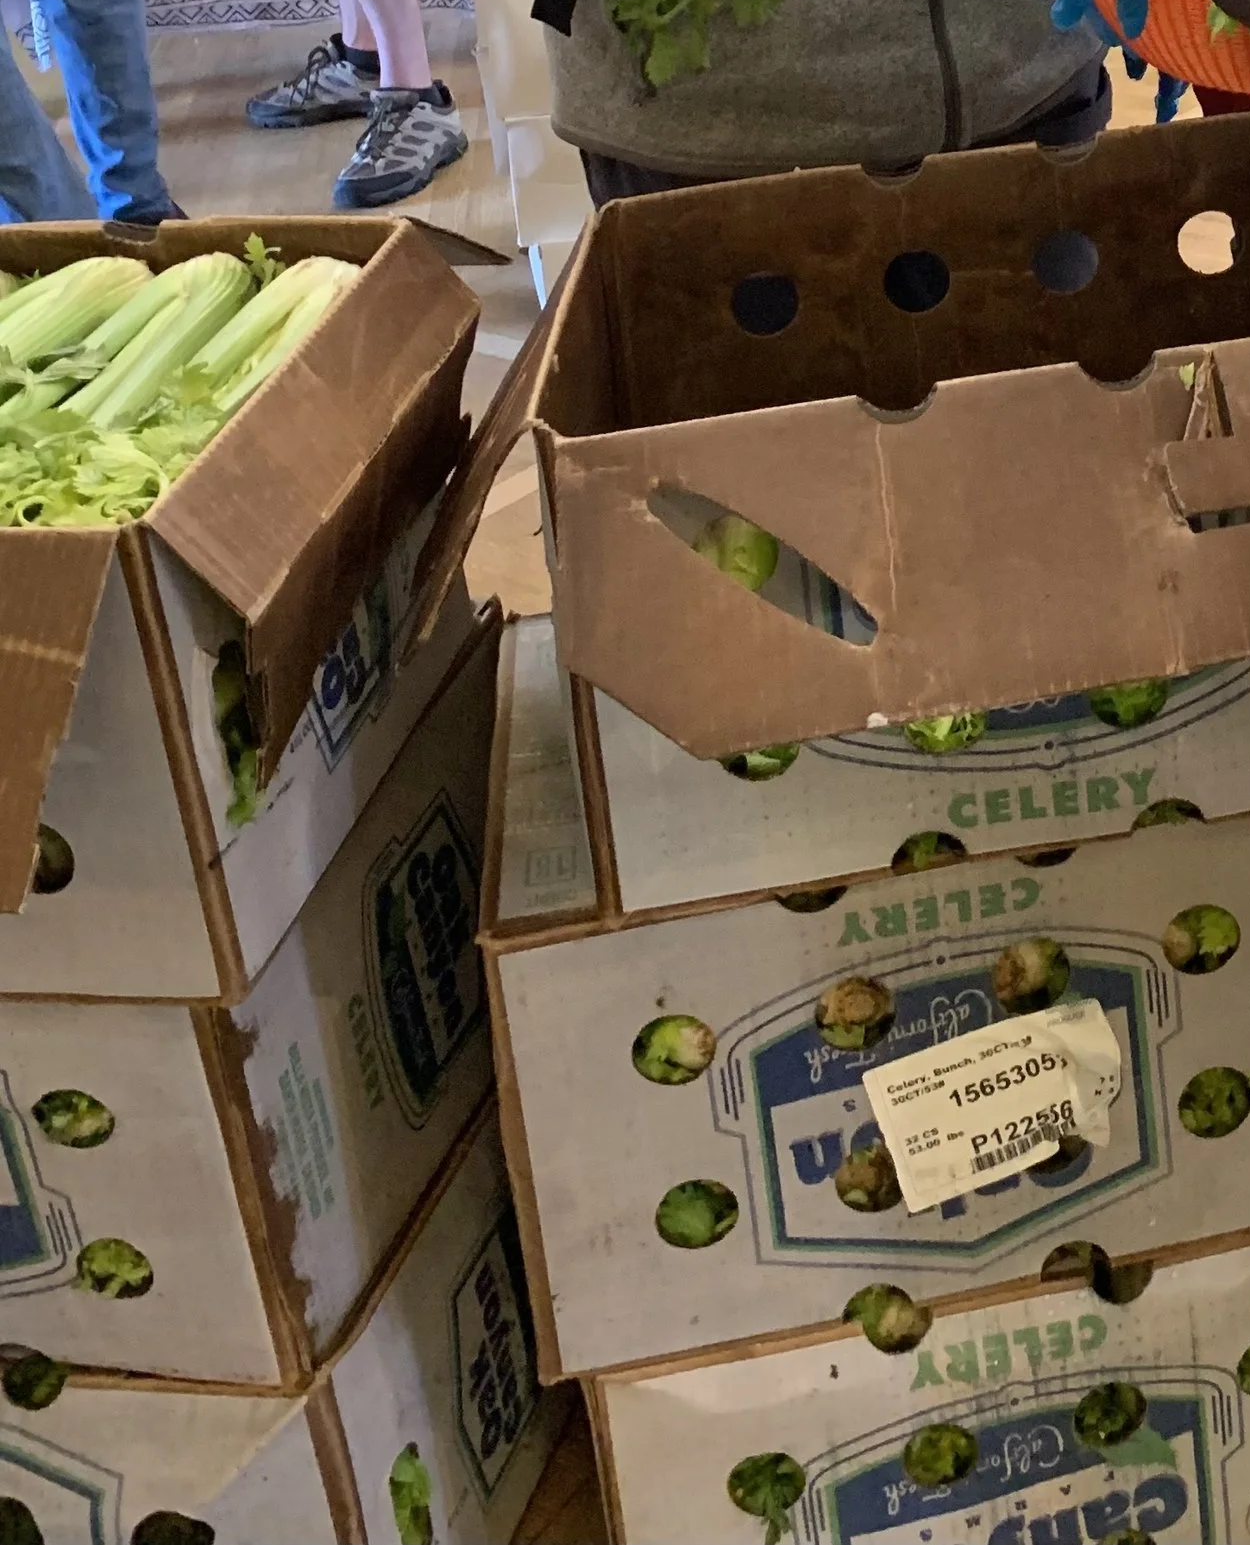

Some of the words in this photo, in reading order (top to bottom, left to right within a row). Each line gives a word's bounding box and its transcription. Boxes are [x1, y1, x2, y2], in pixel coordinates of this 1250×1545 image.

[946, 768, 1160, 830] CELERY
[838, 877, 1041, 948] CELERY
[886, 988, 993, 1052] Californi
[909, 1313, 1107, 1393] CELERY
